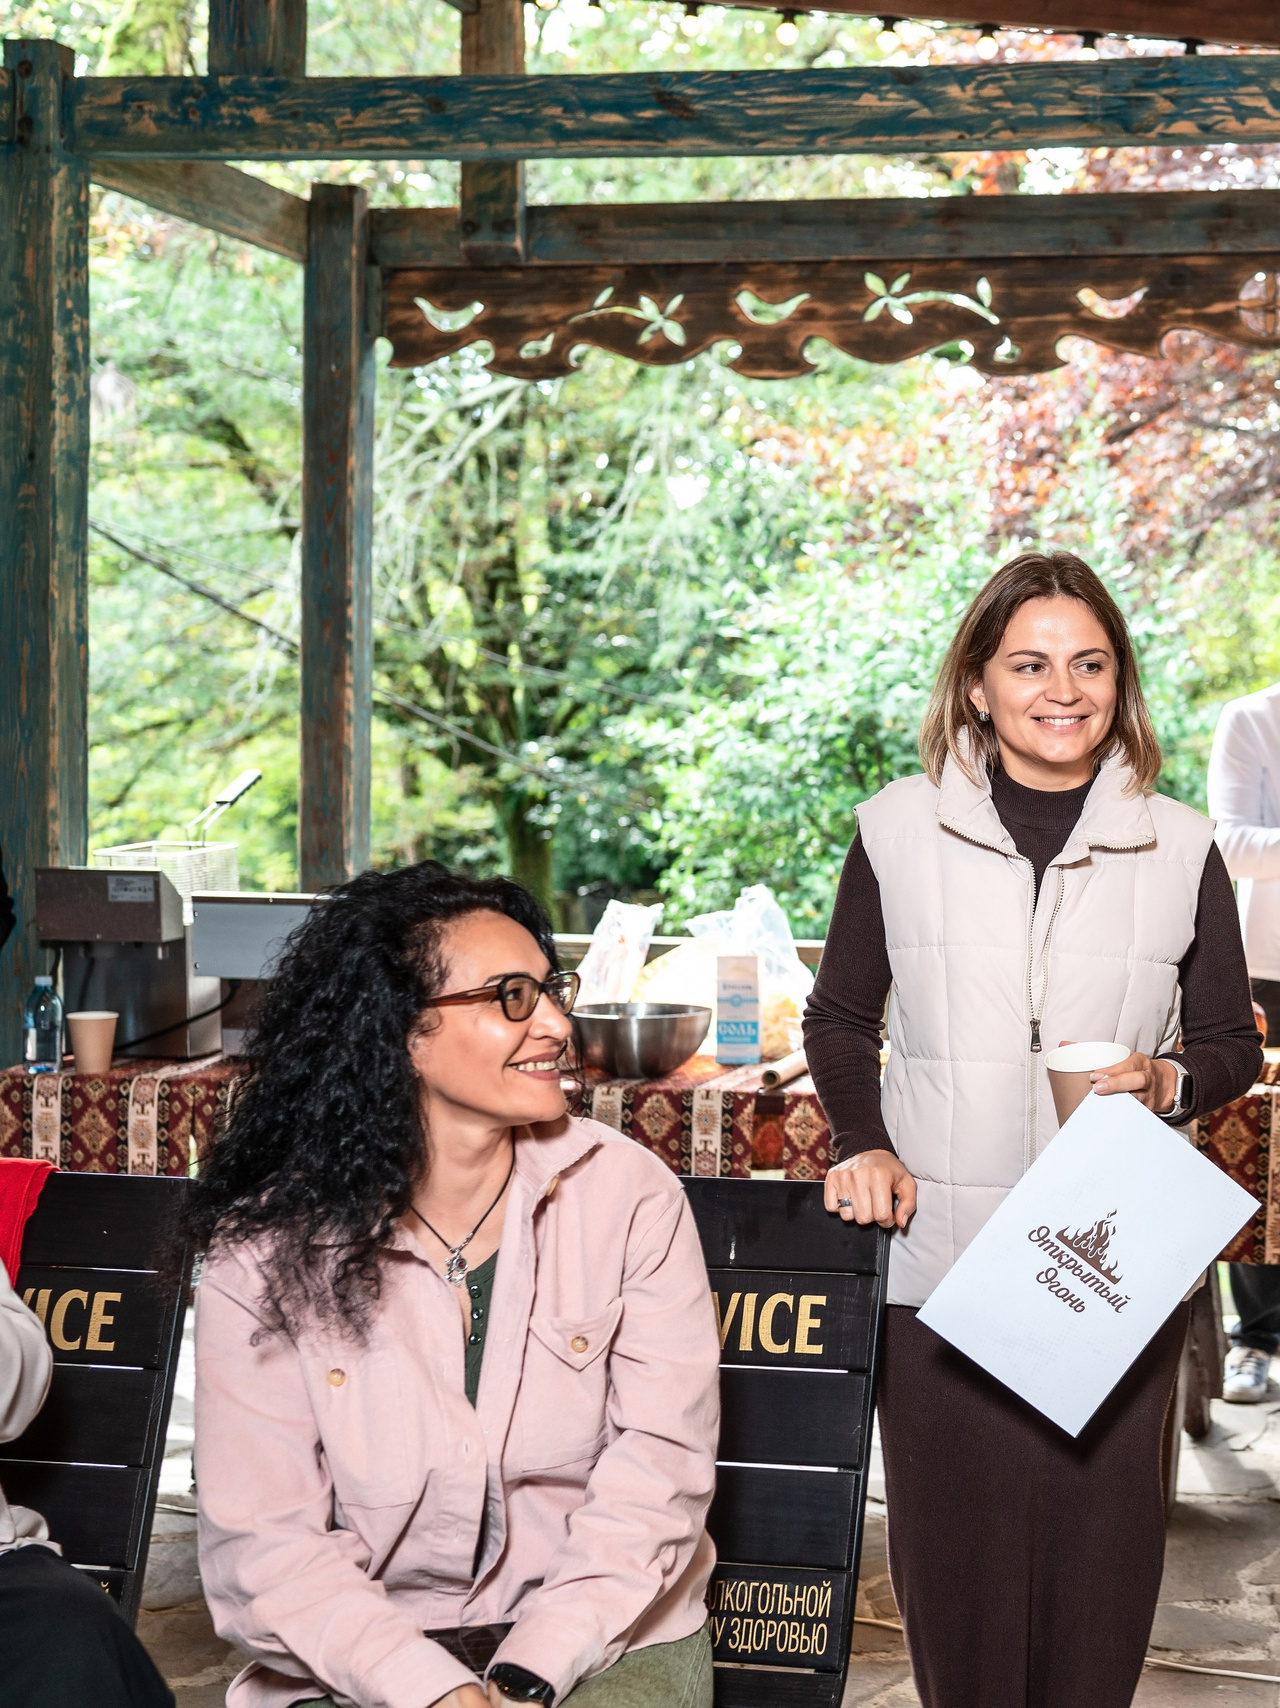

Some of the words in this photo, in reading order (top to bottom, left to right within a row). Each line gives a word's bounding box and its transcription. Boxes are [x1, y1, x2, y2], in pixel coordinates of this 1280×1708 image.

[718, 1022, 757, 1036] СОЛЬ
[1027, 1225, 1132, 1314] Открытый
[1035, 1266, 1086, 1314] Огонь
[709, 1616, 727, 1648] У
[728, 1616, 828, 1656] ЗДОРОВЬЮ
